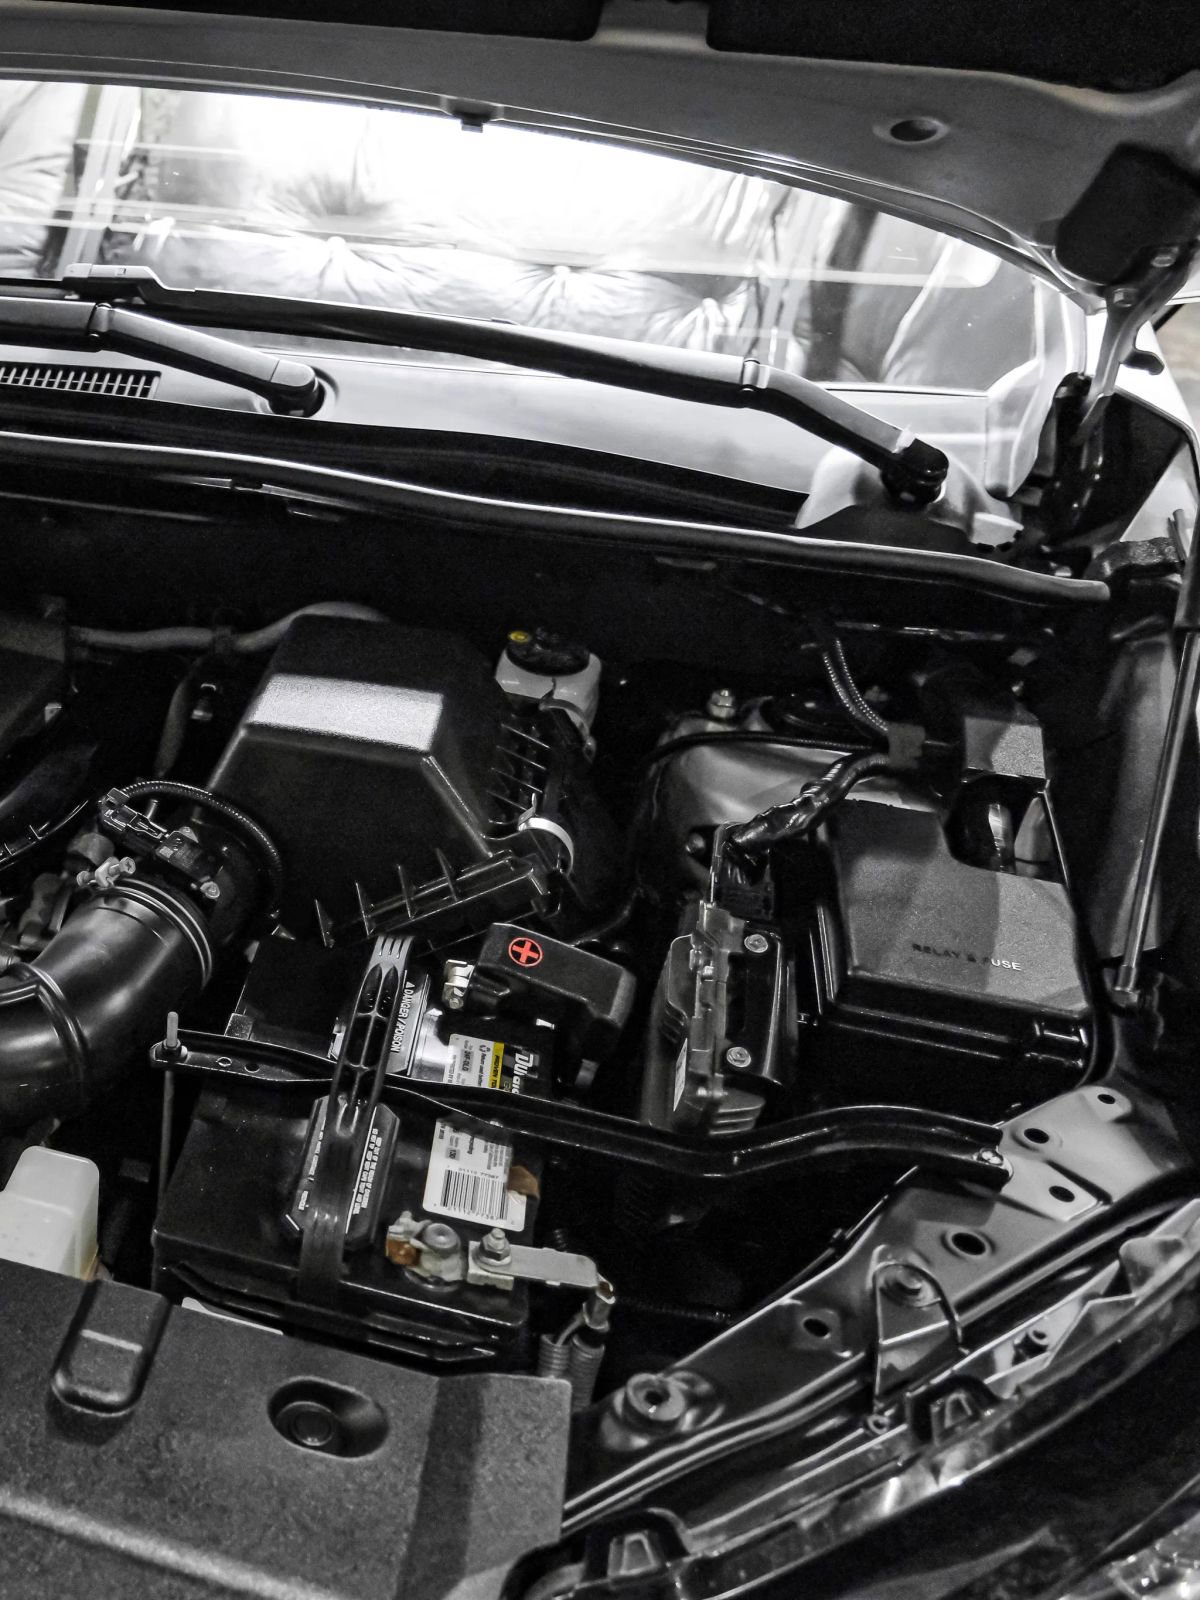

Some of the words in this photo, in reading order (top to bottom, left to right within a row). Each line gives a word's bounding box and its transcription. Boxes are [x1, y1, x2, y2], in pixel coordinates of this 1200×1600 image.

[911, 943, 960, 958] RELAY
[398, 989, 414, 1018] DANGER
[390, 1022, 406, 1053] POISON
